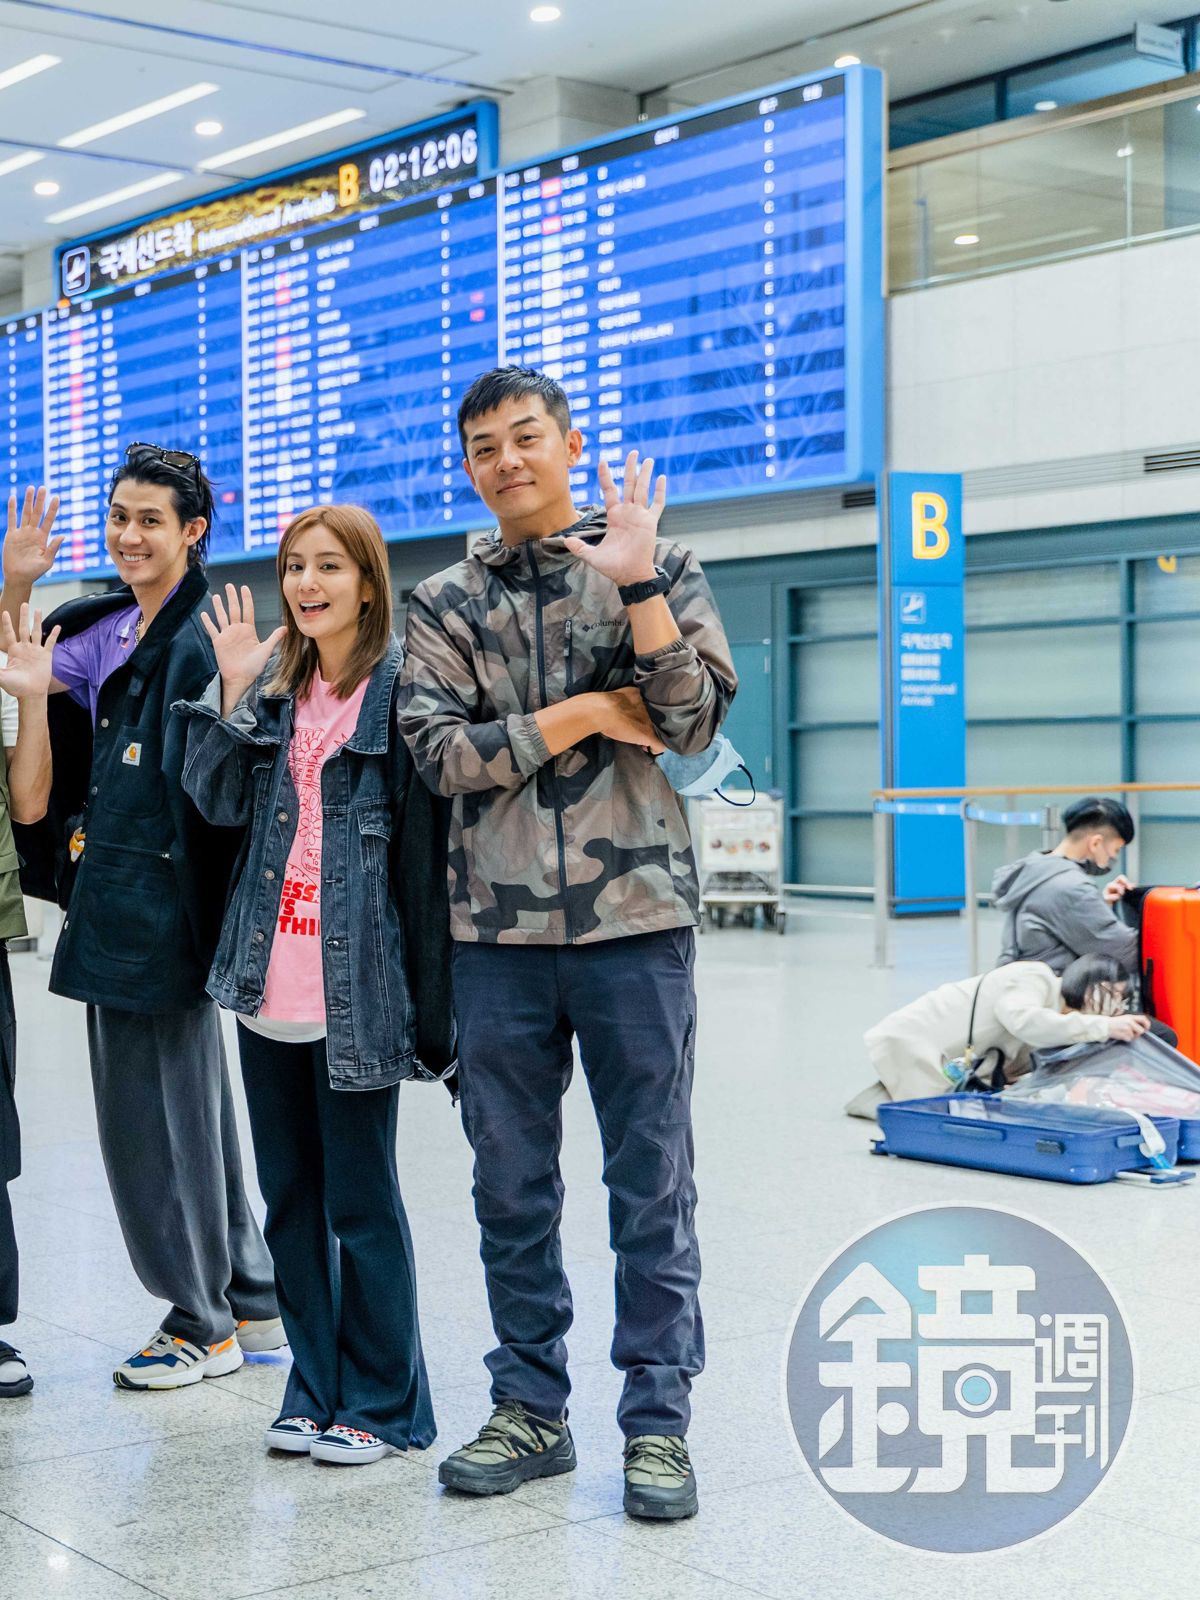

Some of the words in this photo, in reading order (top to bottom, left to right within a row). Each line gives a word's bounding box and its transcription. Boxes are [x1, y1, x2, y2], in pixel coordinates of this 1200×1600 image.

[339, 163, 360, 208] B
[369, 128, 478, 193] 02:12:06
[98, 219, 195, 280] 국제선도착
[911, 492, 950, 560] B
